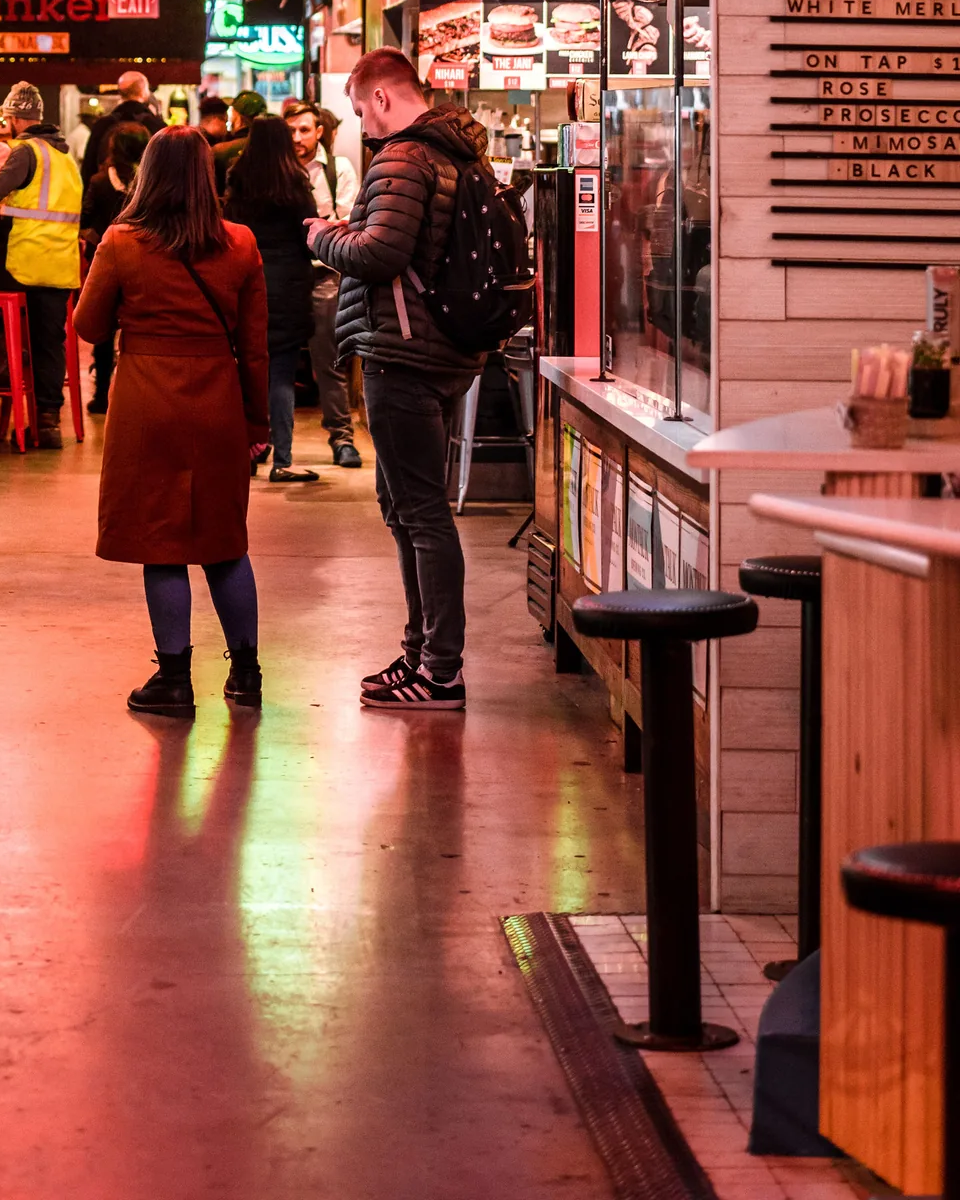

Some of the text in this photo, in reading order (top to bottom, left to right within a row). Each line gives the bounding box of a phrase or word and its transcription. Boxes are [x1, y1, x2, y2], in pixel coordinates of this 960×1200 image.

[787, 0, 960, 17] WHITE MERL
[495, 57, 532, 69] THE JANI
[806, 54, 837, 68] ON
[861, 55, 907, 69] TAP
[435, 68, 465, 80] NIHARI
[823, 81, 887, 96] ROSE
[852, 135, 956, 150] MIMOSA
[852, 163, 936, 178] BLACK
